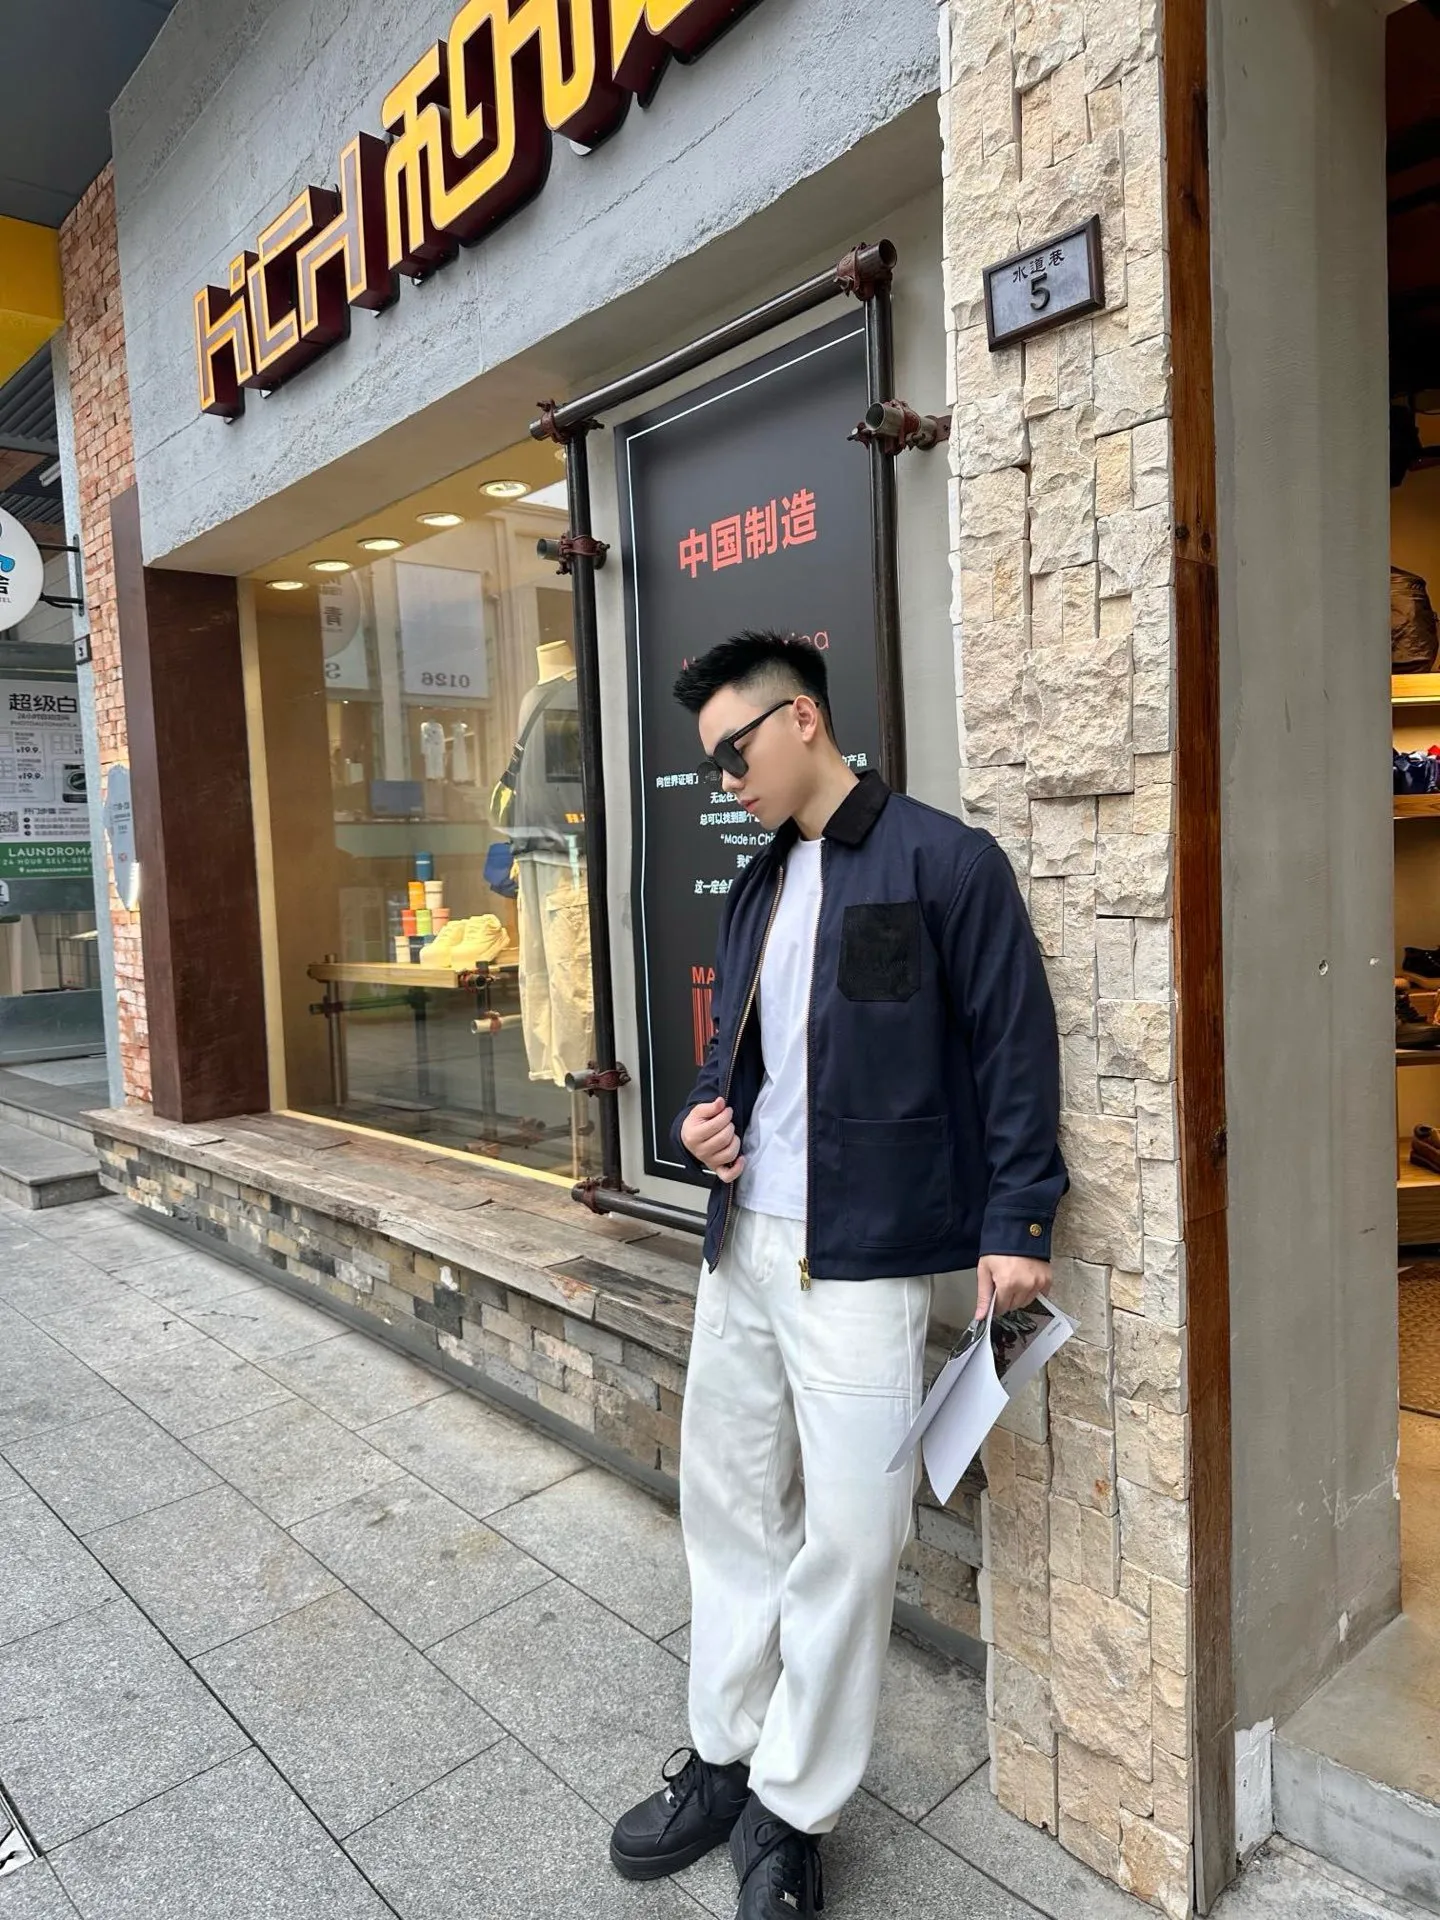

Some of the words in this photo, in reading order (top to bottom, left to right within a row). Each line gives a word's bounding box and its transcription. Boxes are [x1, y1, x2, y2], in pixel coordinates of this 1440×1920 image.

[1013, 249, 1066, 283] 水道巷
[1030, 272, 1051, 311] 5
[678, 488, 818, 578] 中国制造
[9, 693, 77, 713] 超级白
[699, 811, 760, 826] 总可以找到那个
[749, 833, 757, 845] in
